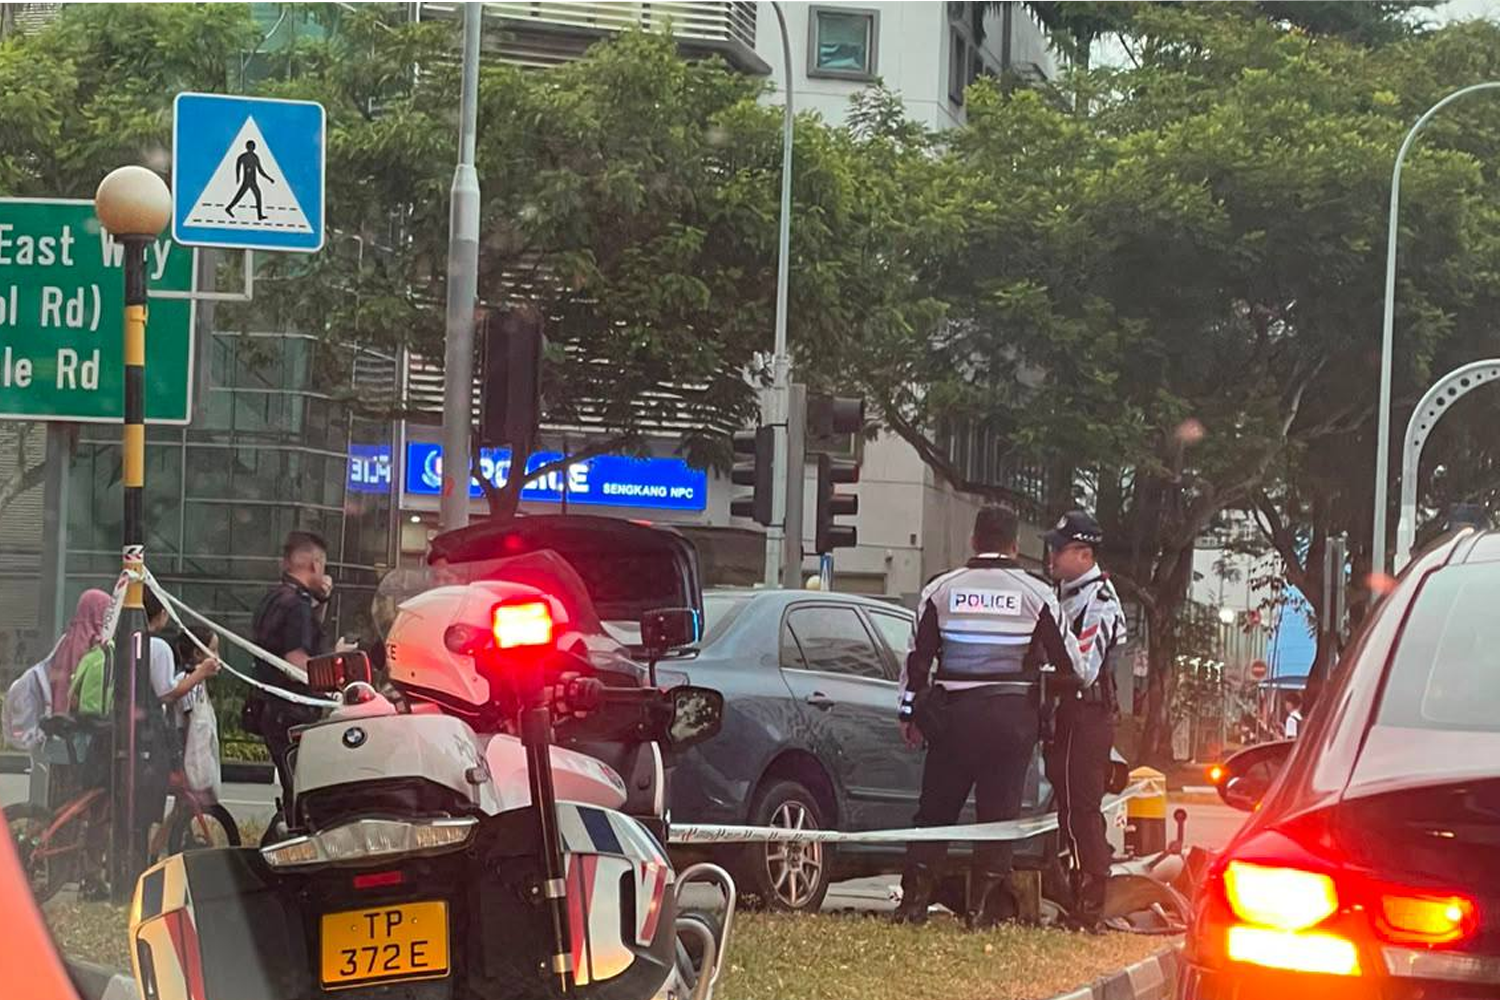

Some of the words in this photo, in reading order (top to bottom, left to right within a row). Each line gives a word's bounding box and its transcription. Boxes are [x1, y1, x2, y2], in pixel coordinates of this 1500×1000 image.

[100, 226, 172, 281] Wy
[40, 284, 101, 332] Rd)
[56, 348, 100, 390] Rd
[603, 483, 667, 498] SENGKANG
[671, 486, 694, 499] NPC
[956, 594, 1016, 609] POLICE
[363, 910, 403, 939] TP
